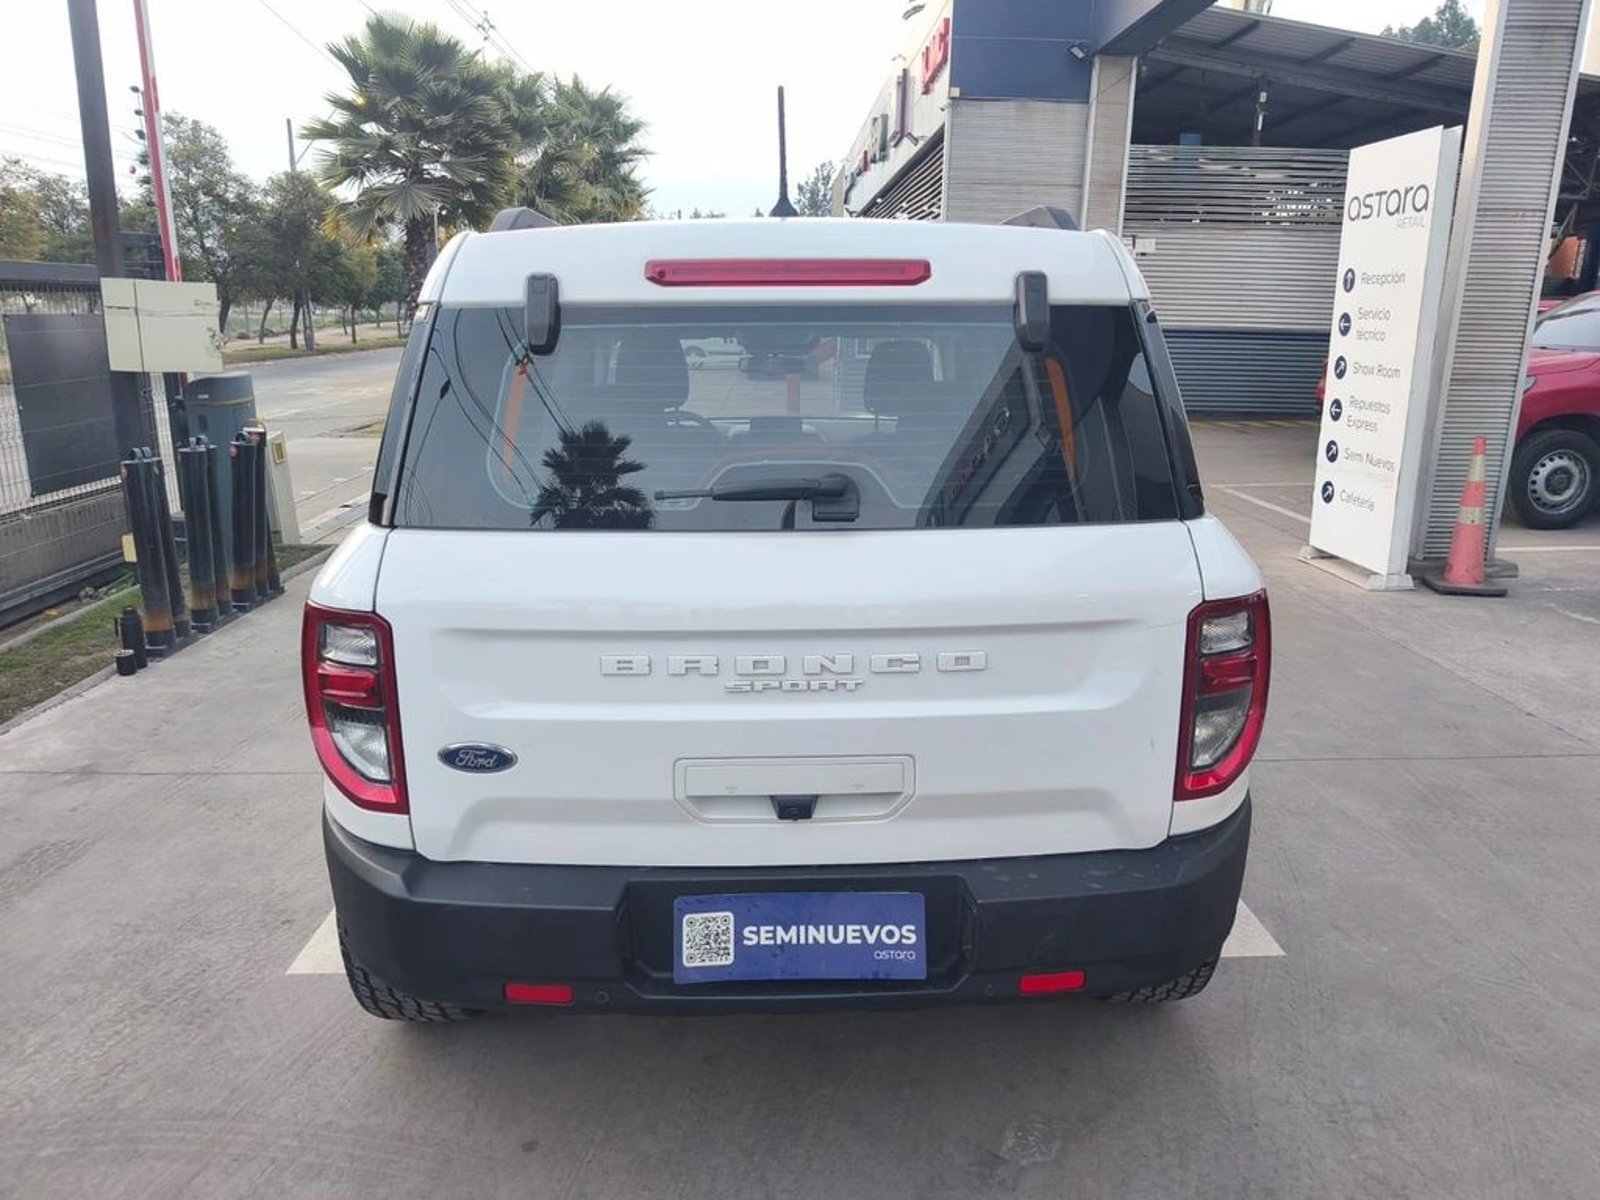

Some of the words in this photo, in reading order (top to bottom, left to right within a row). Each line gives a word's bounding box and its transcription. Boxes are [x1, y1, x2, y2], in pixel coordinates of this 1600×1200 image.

[1347, 183, 1430, 222] astara
[1356, 306, 1392, 322] Servicio
[1352, 361, 1375, 376] Show
[1375, 363, 1401, 379] Room
[1348, 395, 1391, 415] Repuestos
[1345, 414, 1379, 433] Express
[1343, 447, 1364, 463] Semi
[1365, 453, 1396, 473] Nuevos
[600, 650, 988, 676] BRONCO
[724, 678, 864, 693] SPORT
[454, 748, 498, 769] Ford
[742, 924, 918, 946] SEMINUEVOS
[873, 950, 917, 961] astara
